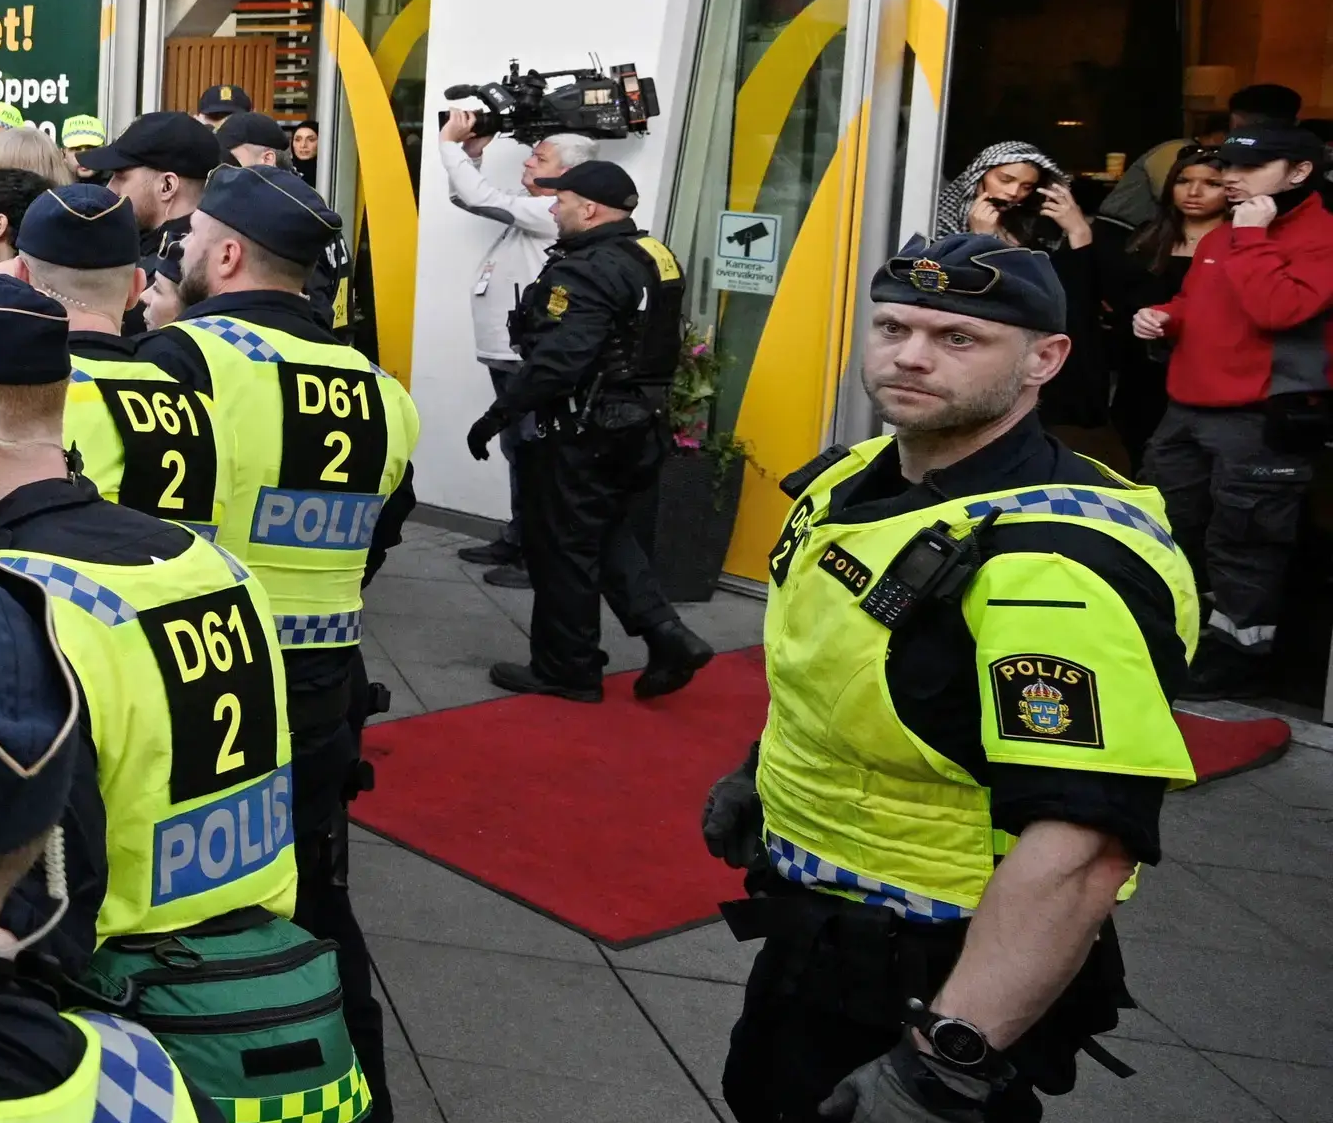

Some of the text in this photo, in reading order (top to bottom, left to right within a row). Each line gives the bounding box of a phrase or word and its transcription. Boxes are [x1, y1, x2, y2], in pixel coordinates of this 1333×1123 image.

[716, 268, 774, 283] övervakning
[726, 260, 765, 271] Kamera-
[117, 390, 199, 436] D61
[296, 373, 370, 420] D61
[157, 450, 185, 509] 2
[320, 430, 352, 483] 2
[257, 493, 381, 544] POLIS
[771, 540, 791, 571] 2
[824, 550, 867, 588] POLIS
[163, 604, 253, 683] D61
[999, 660, 1082, 684] POLIS
[213, 692, 245, 775] 2
[159, 776, 289, 896] POLIS
